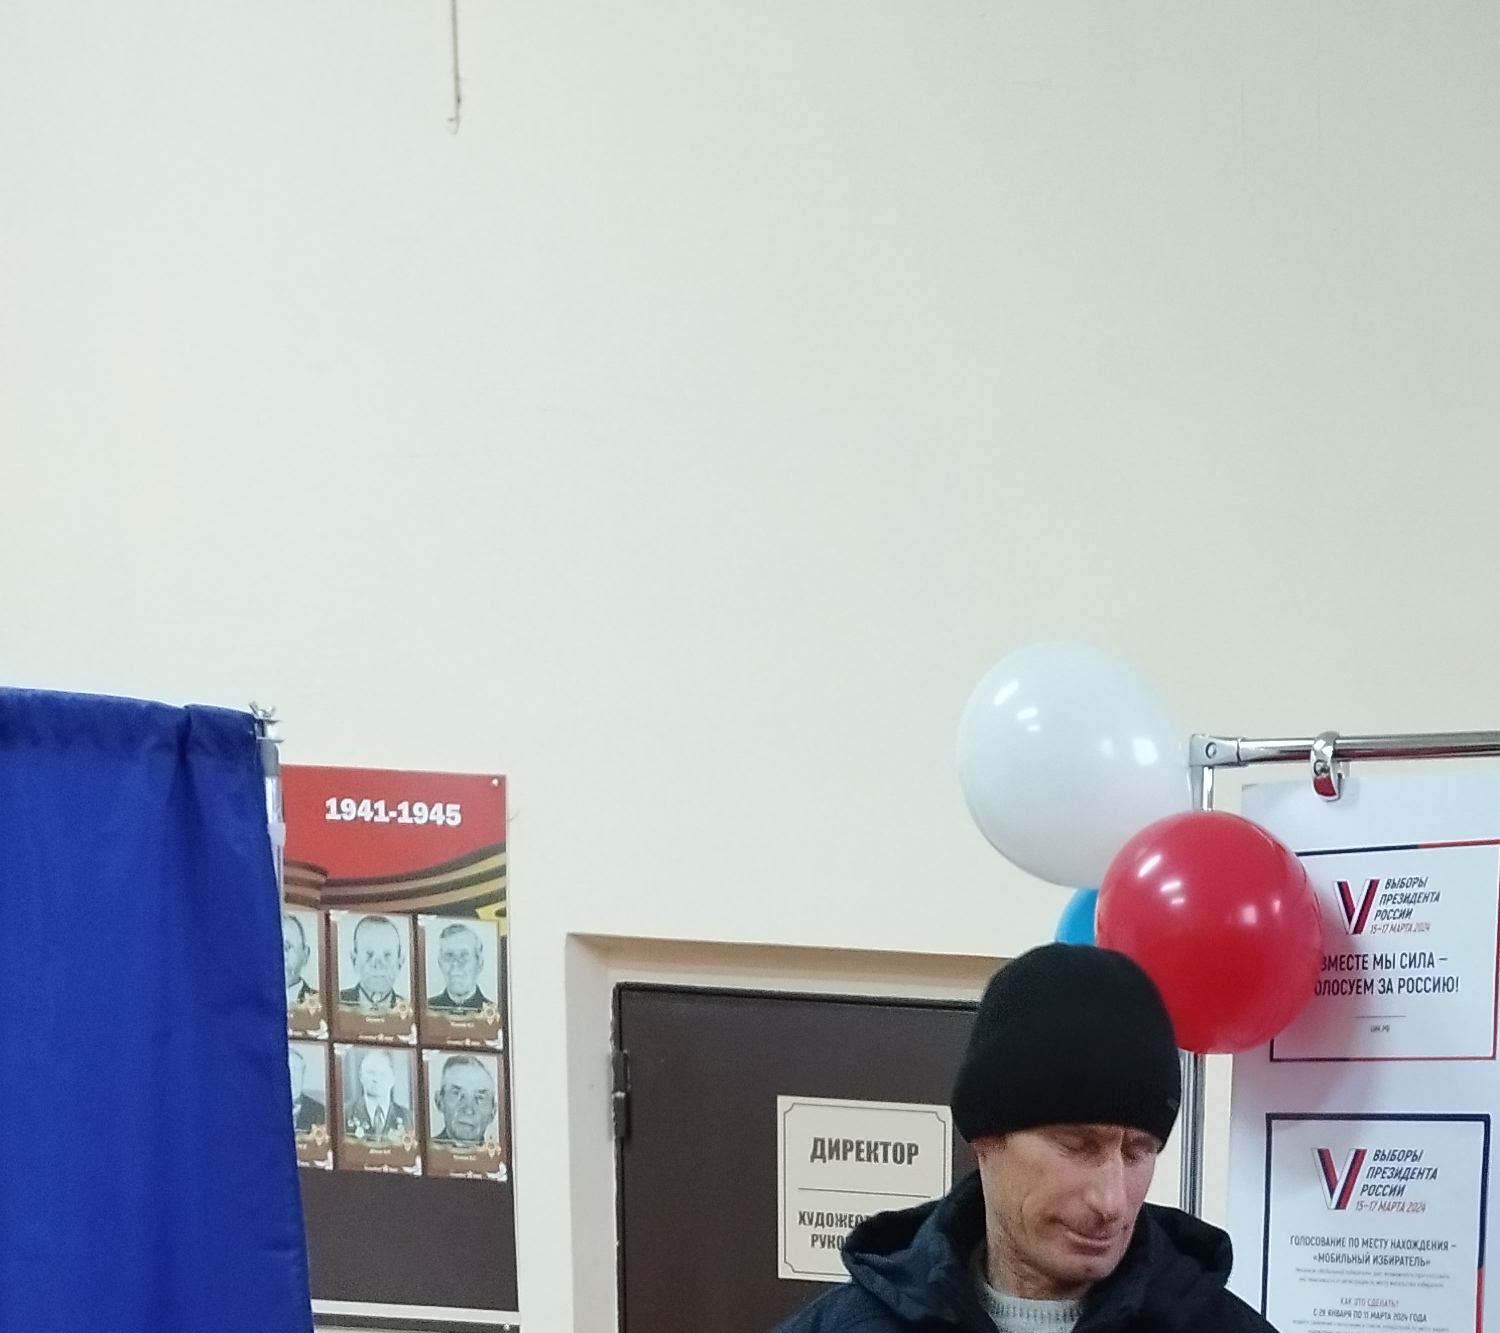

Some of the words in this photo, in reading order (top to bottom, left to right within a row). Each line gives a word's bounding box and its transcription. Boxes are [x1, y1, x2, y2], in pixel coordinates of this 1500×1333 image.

[325, 797, 462, 826] 1941-1945
[1384, 876, 1429, 890] ВЫБОРЫ
[1379, 891, 1441, 906] ПРЕЗИДЕНТА
[1374, 908, 1414, 921] РОССИИ
[1372, 953, 1396, 970] МЫ
[1400, 951, 1435, 969] СИЛА
[1314, 977, 1374, 996] ОЛОСУЕМ
[1378, 977, 1394, 995] ЗА
[1398, 976, 1460, 995] РОССИЮ!
[810, 1137, 919, 1165] ДИРЕКТОР
[1373, 1149, 1424, 1162] ВЫБОРЫ
[1366, 1167, 1439, 1181] ПРЕЗИДЕНТА
[1360, 1184, 1406, 1197] РОССИИ
[1378, 1201, 1405, 1212] МАРТА
[1406, 1202, 1427, 1213] 2024
[798, 1210, 868, 1229] ХУДОЖЕС
[810, 1234, 847, 1250] РУКО
[1290, 1235, 1346, 1248] ГОЛОСОВАНИЕ
[1348, 1237, 1360, 1248] ПО
[1361, 1238, 1389, 1249] МЕСТУ
[1390, 1239, 1449, 1252] НАХОЖДЕНИЯ
[1313, 1252, 1371, 1265] «МОБИЛЬНЫЙ
[1373, 1255, 1431, 1267] ИЗБИРАТЕЛЬ»
[1370, 1311, 1391, 1320] МАРТА
[1409, 1313, 1427, 1322] ГОДА
